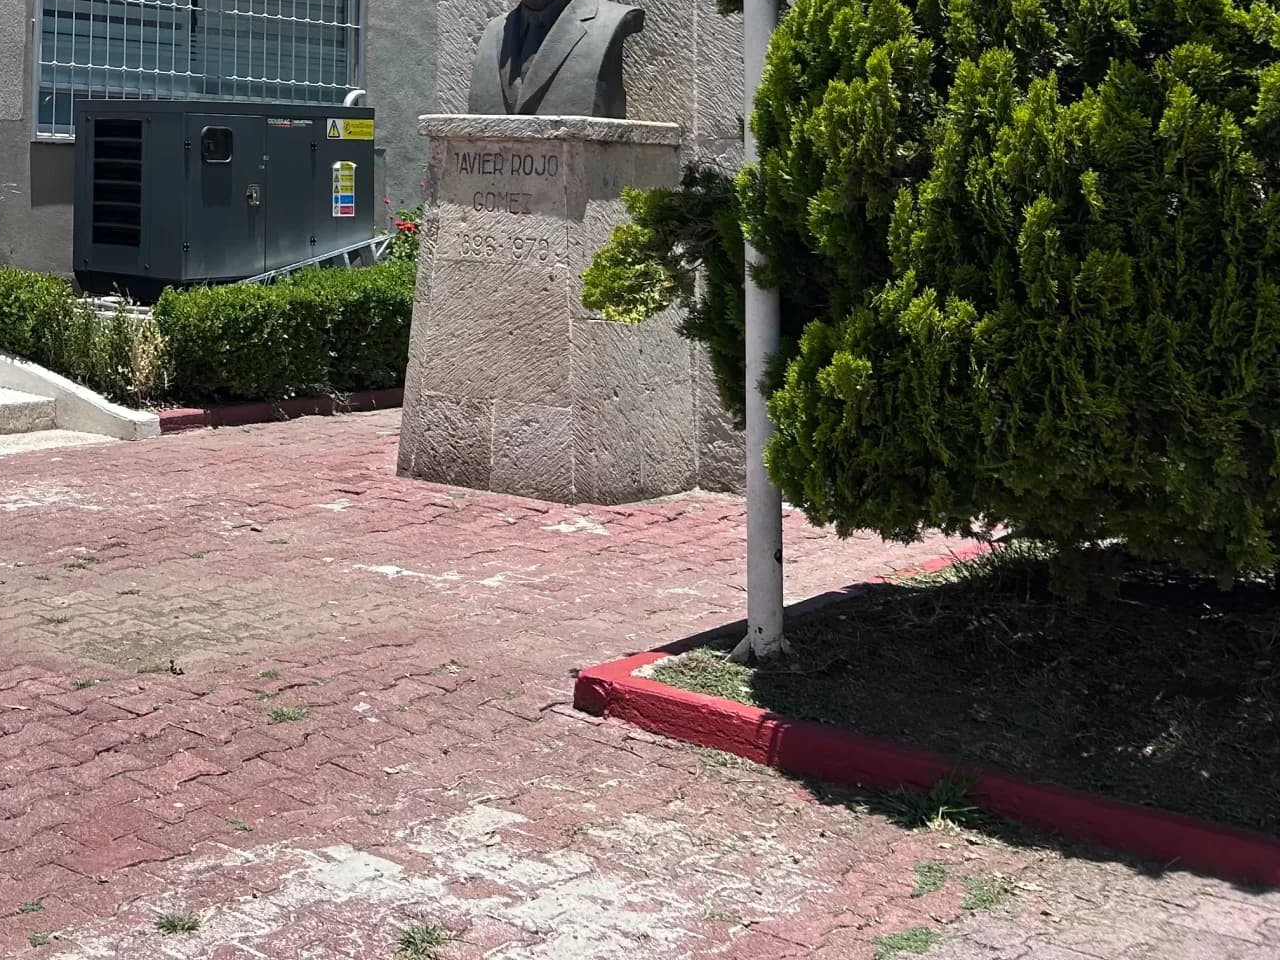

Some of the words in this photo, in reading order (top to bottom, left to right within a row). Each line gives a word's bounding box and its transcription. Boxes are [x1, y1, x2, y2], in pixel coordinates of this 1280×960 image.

[453, 151, 505, 176] JAVIER
[511, 153, 559, 177] ROJO
[472, 191, 533, 215] GOMEZ
